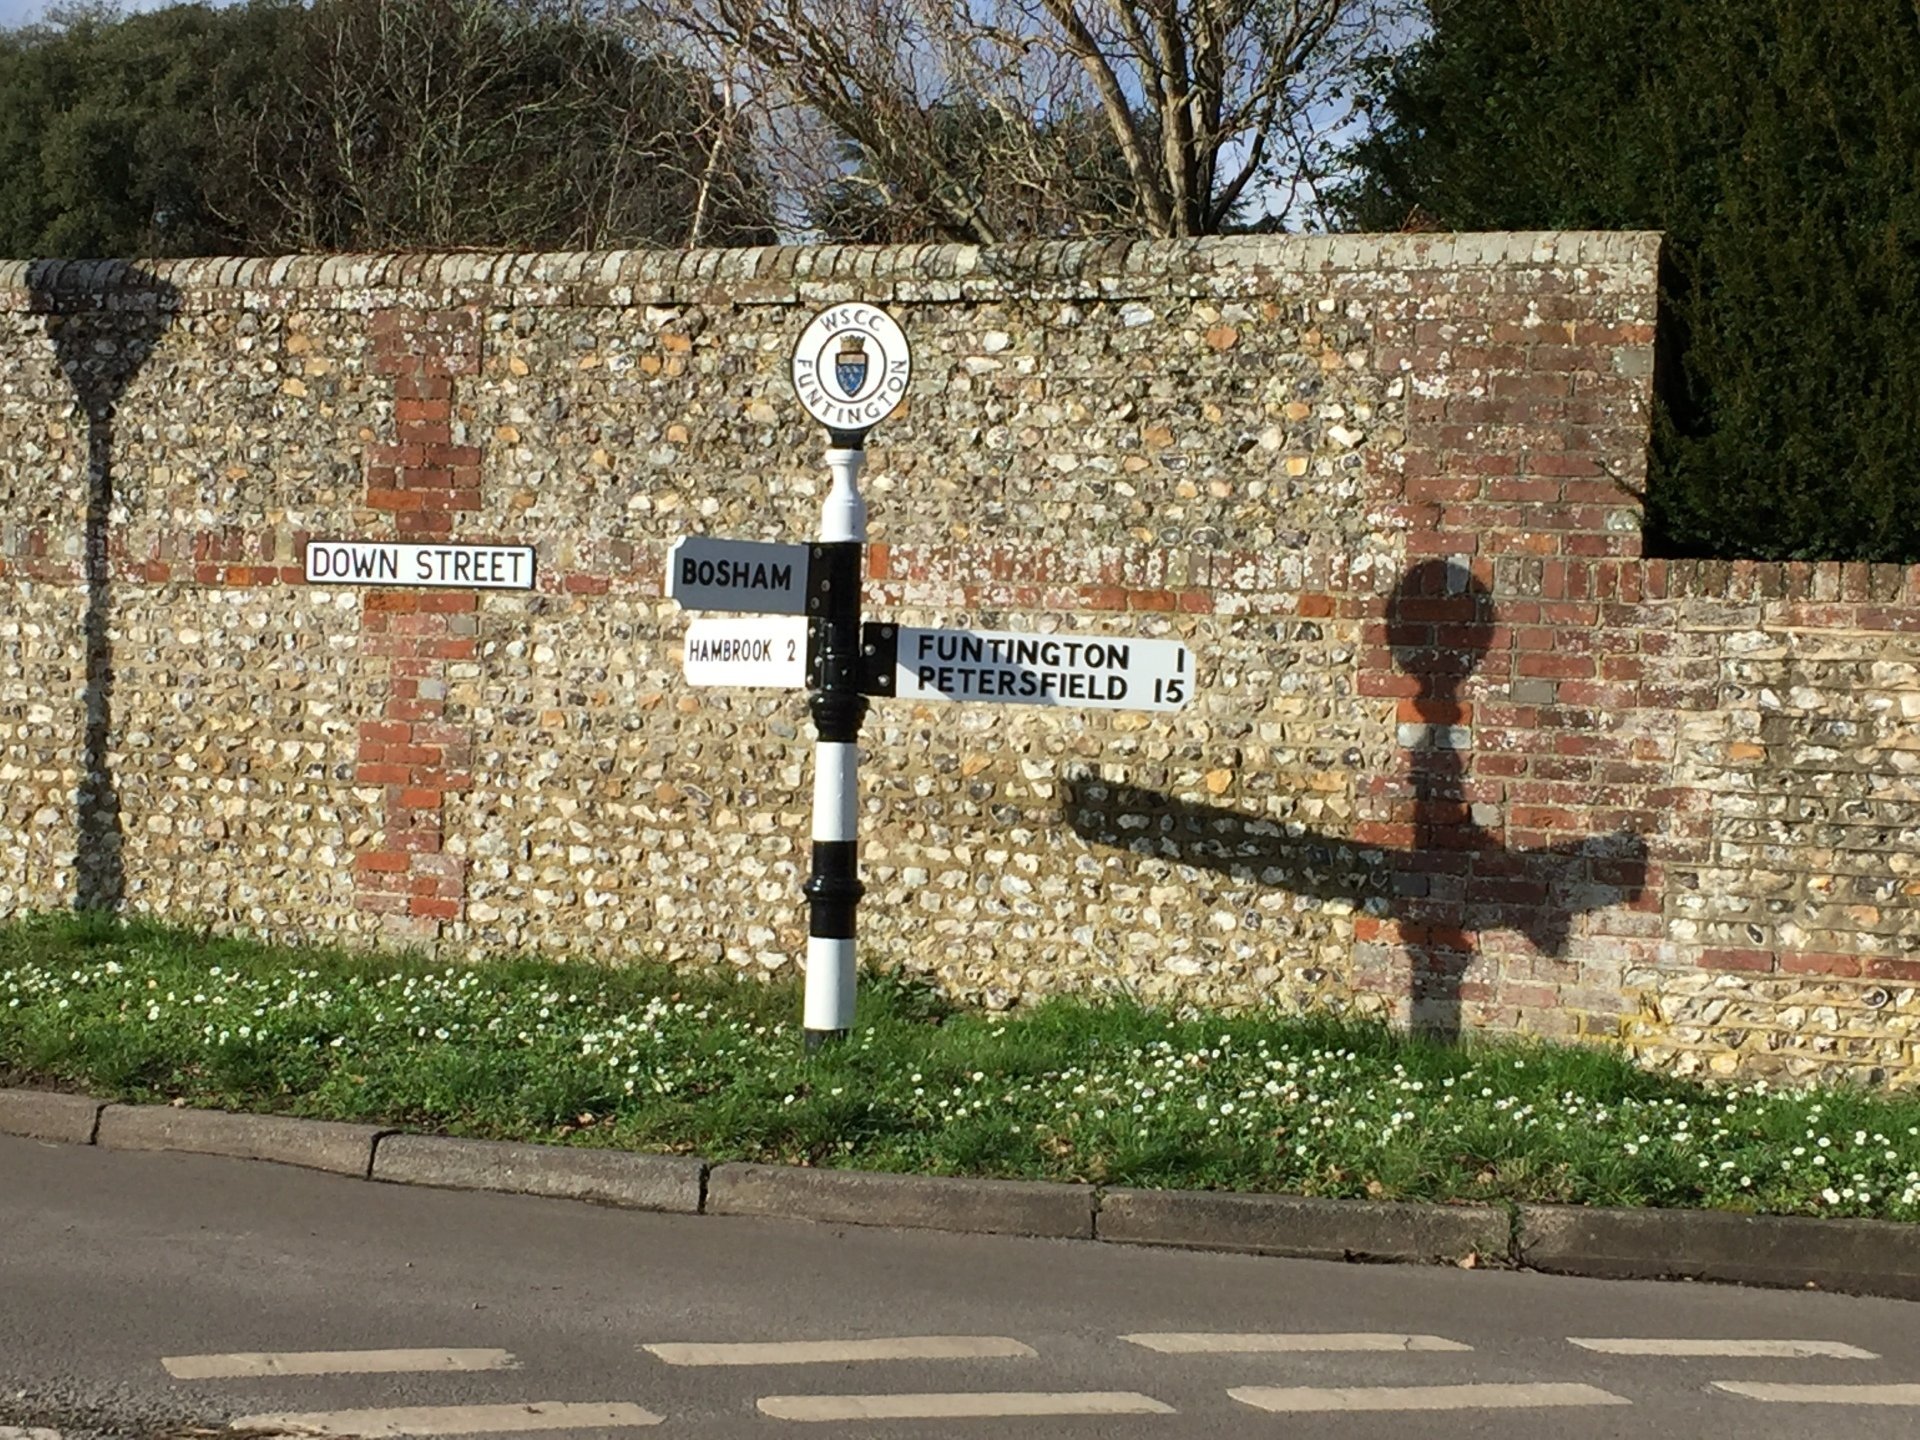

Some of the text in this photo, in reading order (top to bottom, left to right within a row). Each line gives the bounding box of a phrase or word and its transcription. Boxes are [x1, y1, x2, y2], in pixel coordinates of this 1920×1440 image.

[820, 308, 885, 332] WSCC
[797, 359, 907, 424] FUNTINGTON
[313, 547, 526, 582] DOWN STREET
[682, 558, 792, 590] BOSHAM
[689, 639, 796, 662] HAMBROOK 2
[918, 634, 1130, 670] FUNTINGTON
[918, 666, 1184, 703] PETERSFIELD 15
